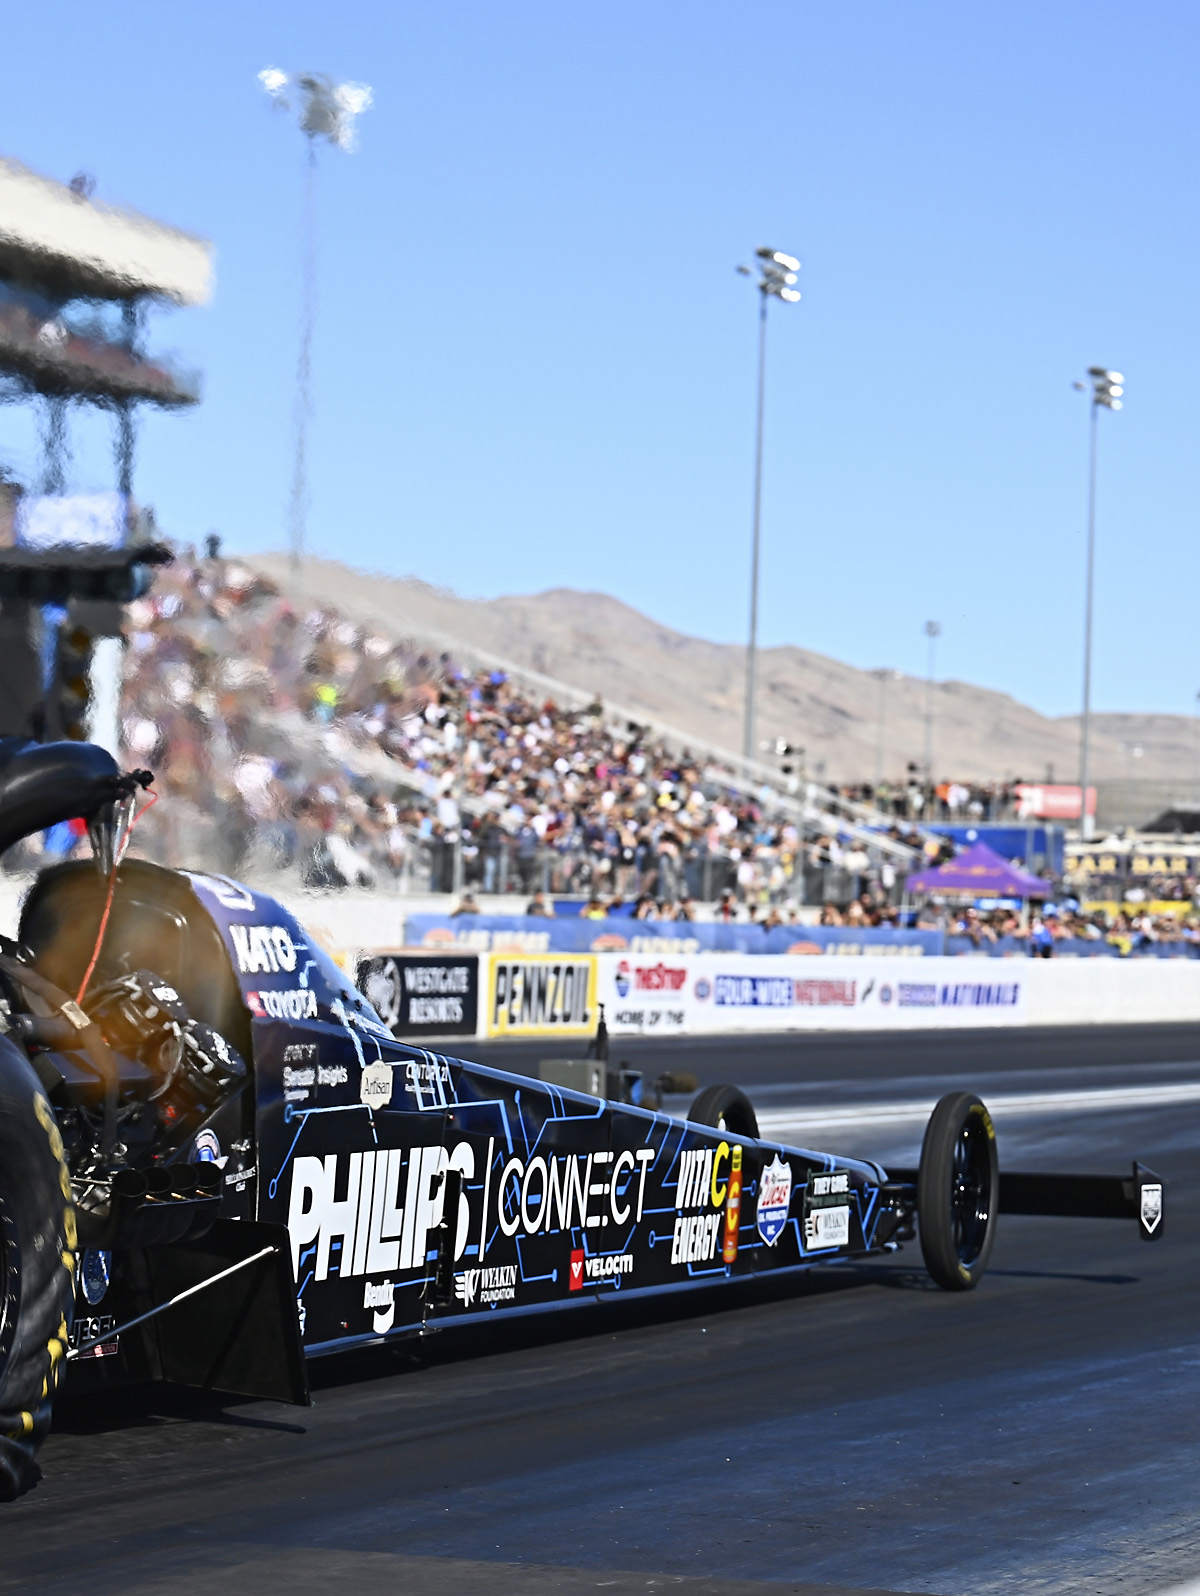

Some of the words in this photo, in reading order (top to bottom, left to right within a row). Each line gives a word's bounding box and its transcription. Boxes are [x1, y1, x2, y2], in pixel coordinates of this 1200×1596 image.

[258, 990, 317, 1019] TOYOTA
[493, 964, 588, 1024] PENNZOIL
[288, 1143, 475, 1283] PHILLIPS
[498, 1149, 655, 1236] CONNECT
[671, 1214, 720, 1264] ENERGY
[481, 1265, 517, 1289] WYAKIN
[585, 1254, 633, 1277] VELOCITI
[364, 1279, 395, 1308] Bendix
[480, 1287, 515, 1302] FOUNDATION
